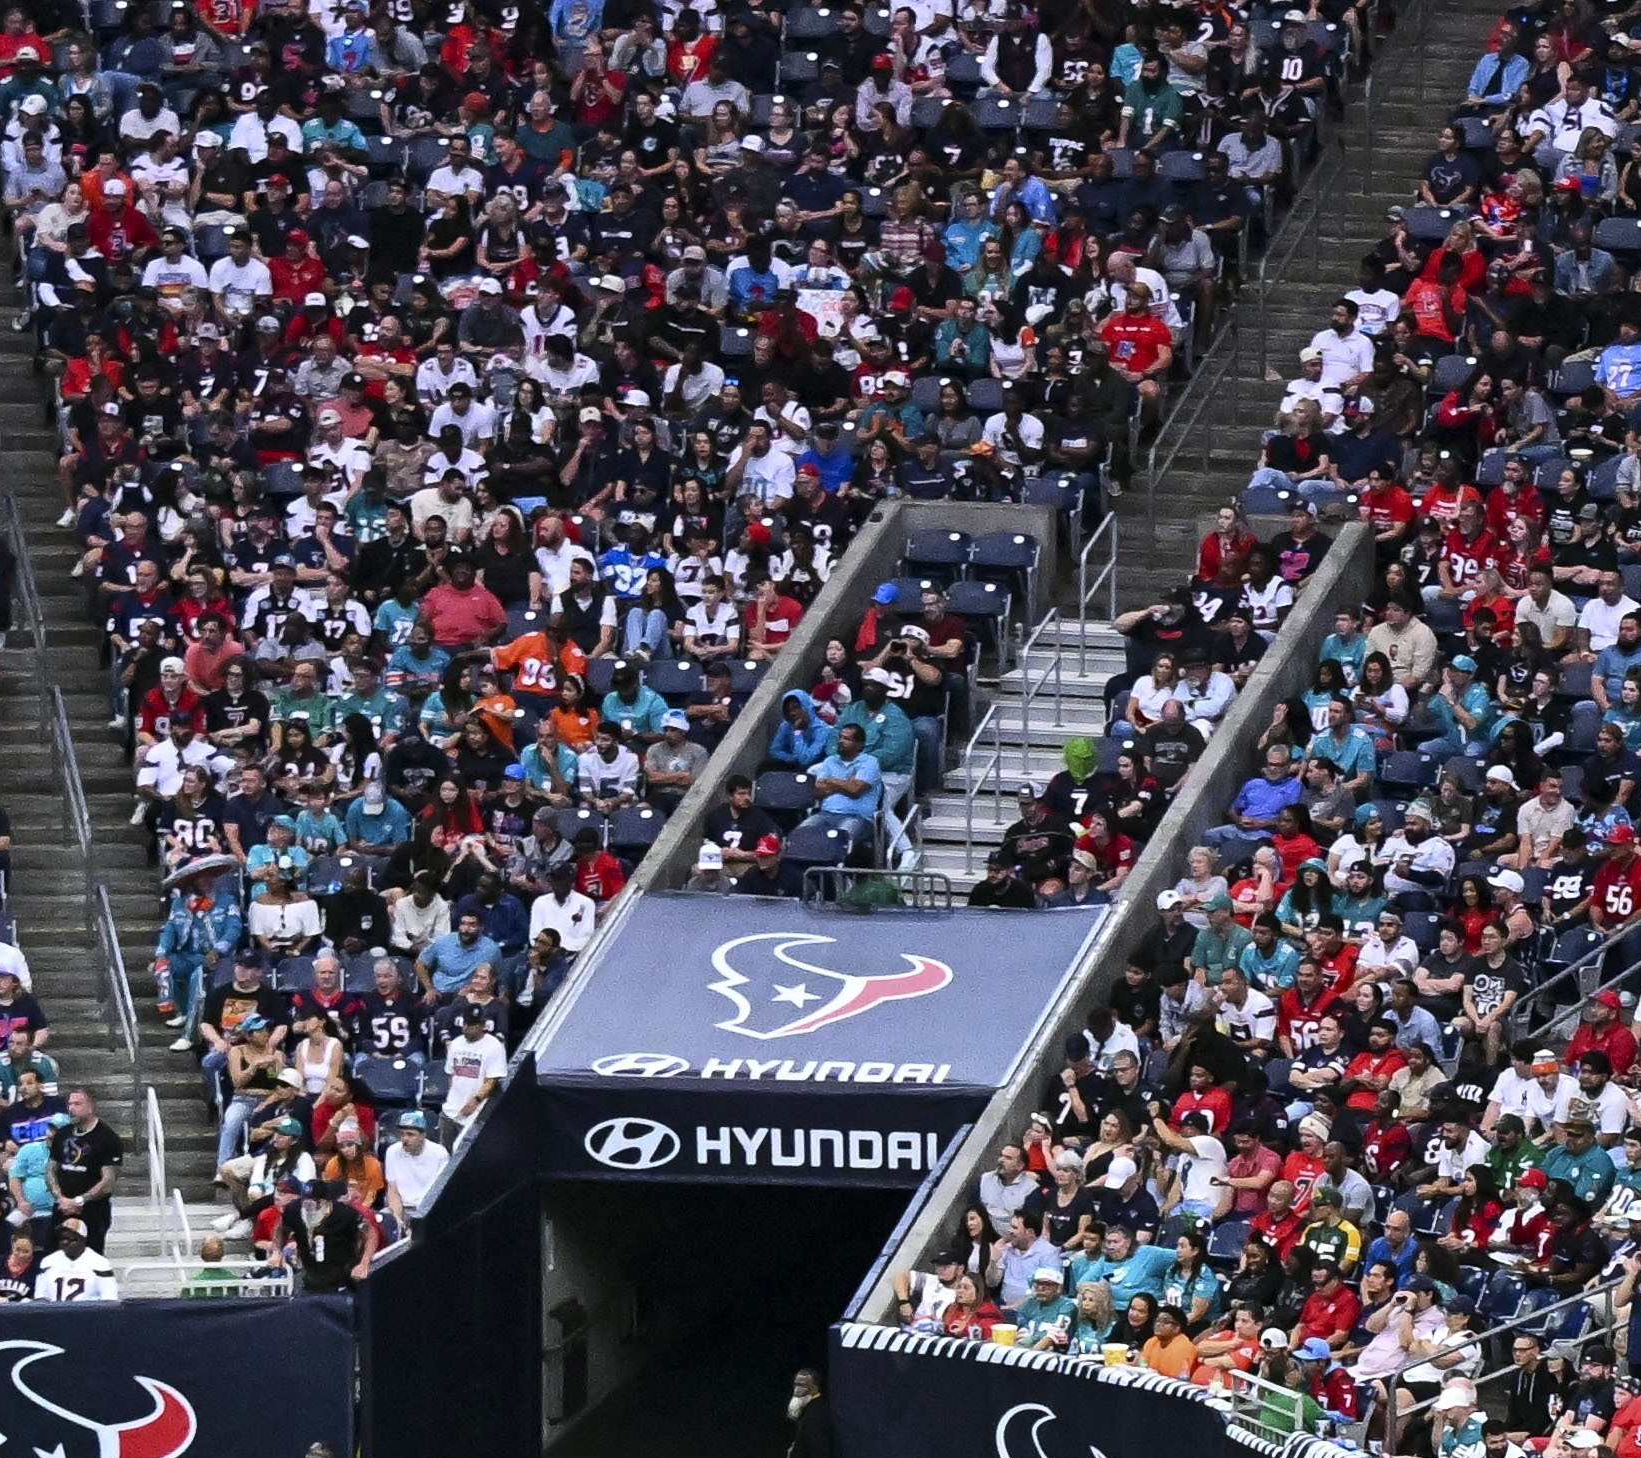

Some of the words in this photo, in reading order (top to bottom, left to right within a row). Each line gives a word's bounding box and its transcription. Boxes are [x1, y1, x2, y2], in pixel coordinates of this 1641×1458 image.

[1281, 58, 1303, 80] 10
[1071, 793, 1087, 815] 7
[1605, 886, 1632, 916] 56
[372, 1017, 409, 1048] 59
[701, 1057, 952, 1084] HYUNDAI
[696, 1126, 938, 1170] HYUNDAI
[55, 1278, 84, 1301] 12
